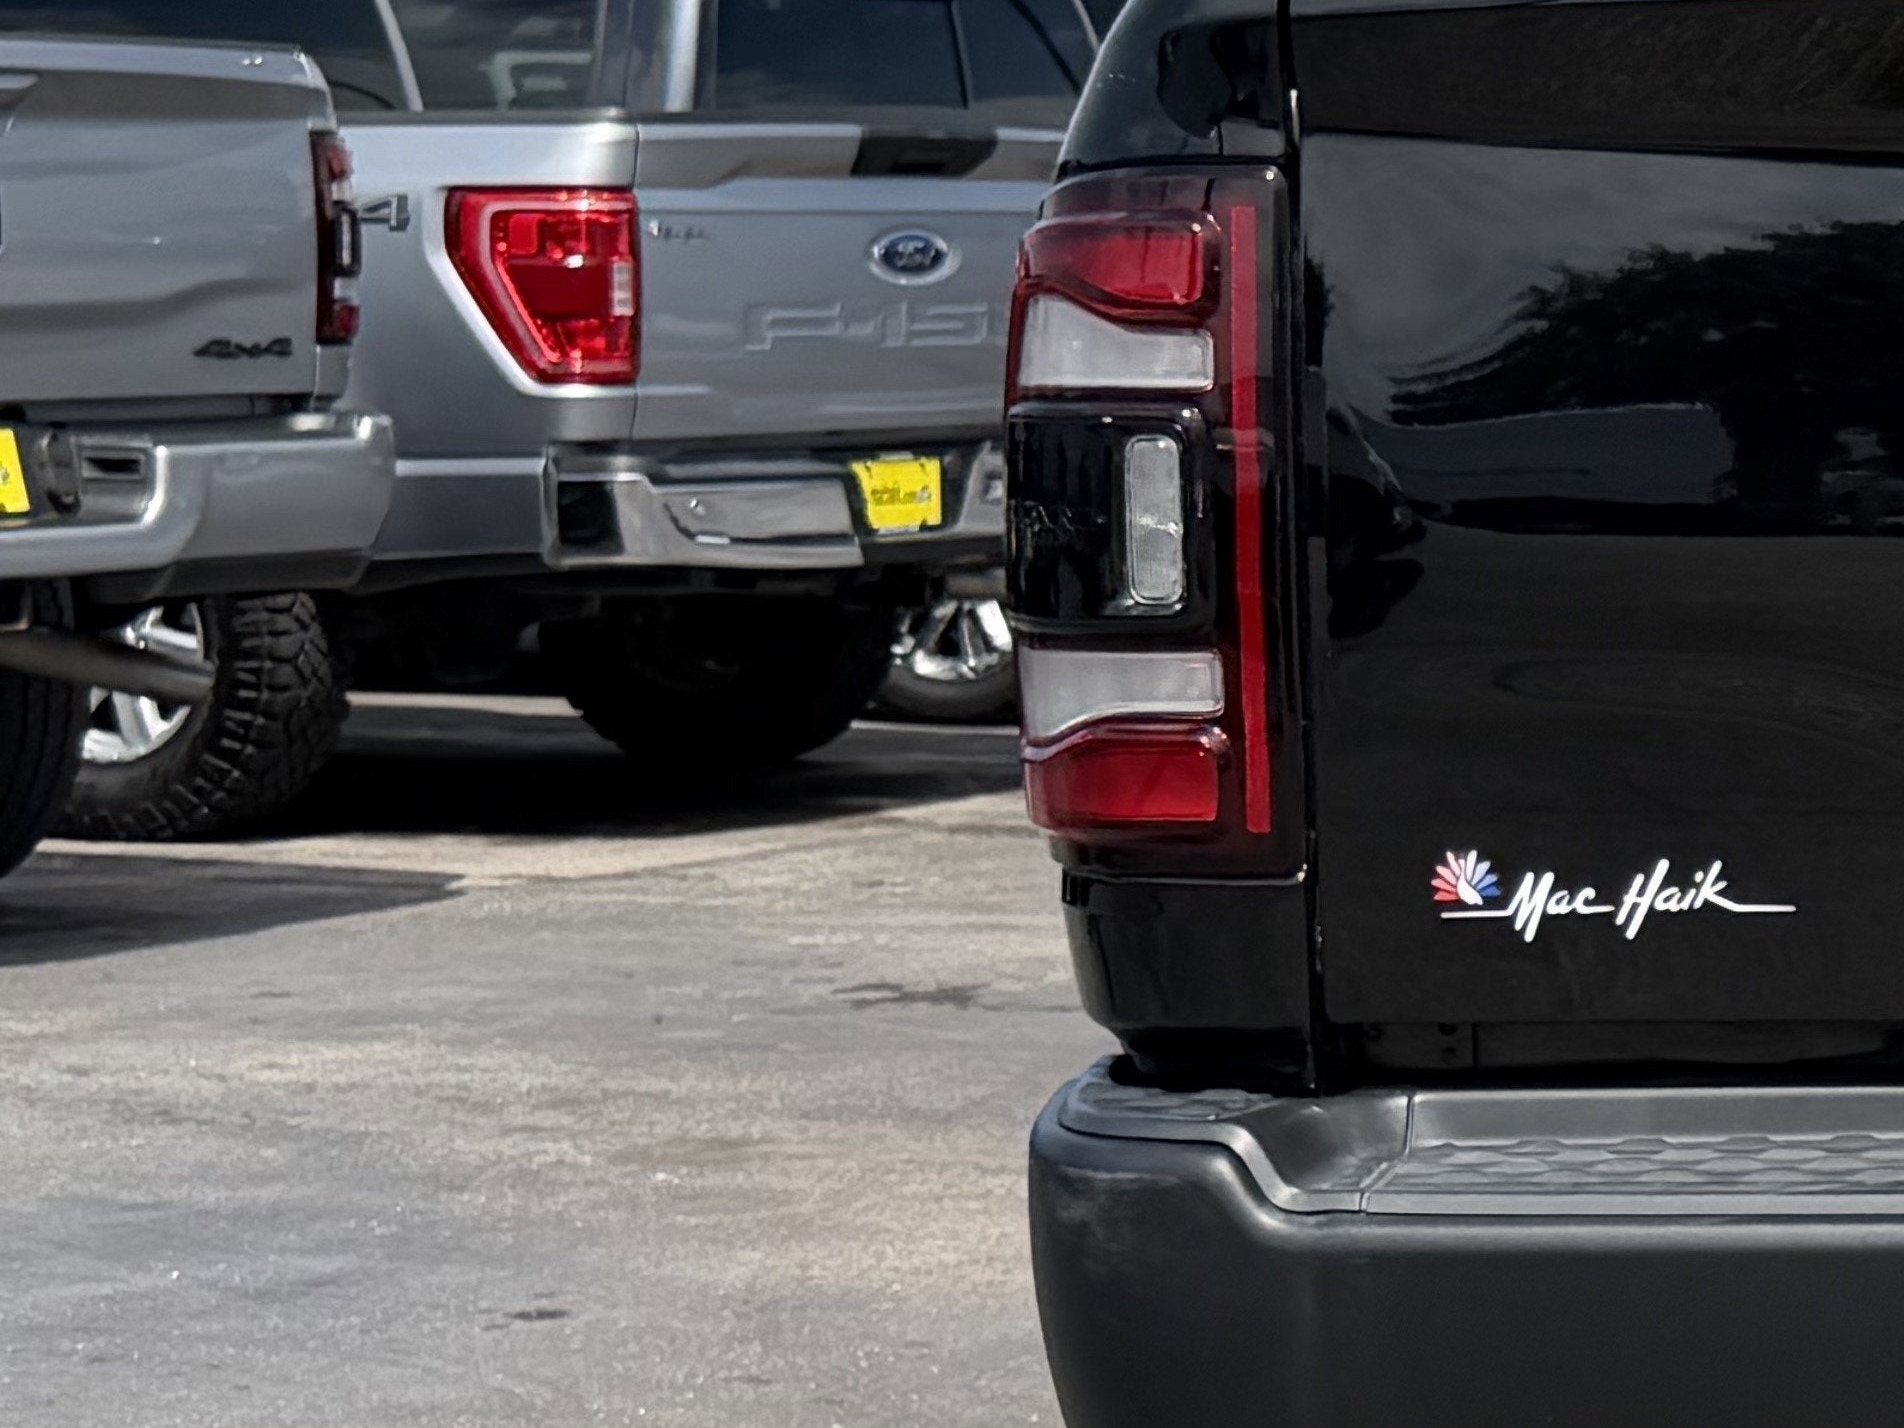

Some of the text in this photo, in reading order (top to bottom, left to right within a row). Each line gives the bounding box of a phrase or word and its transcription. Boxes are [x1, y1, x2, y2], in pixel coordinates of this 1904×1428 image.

[746, 299, 993, 351] F-15
[1505, 858, 1768, 943] Mac Haik
